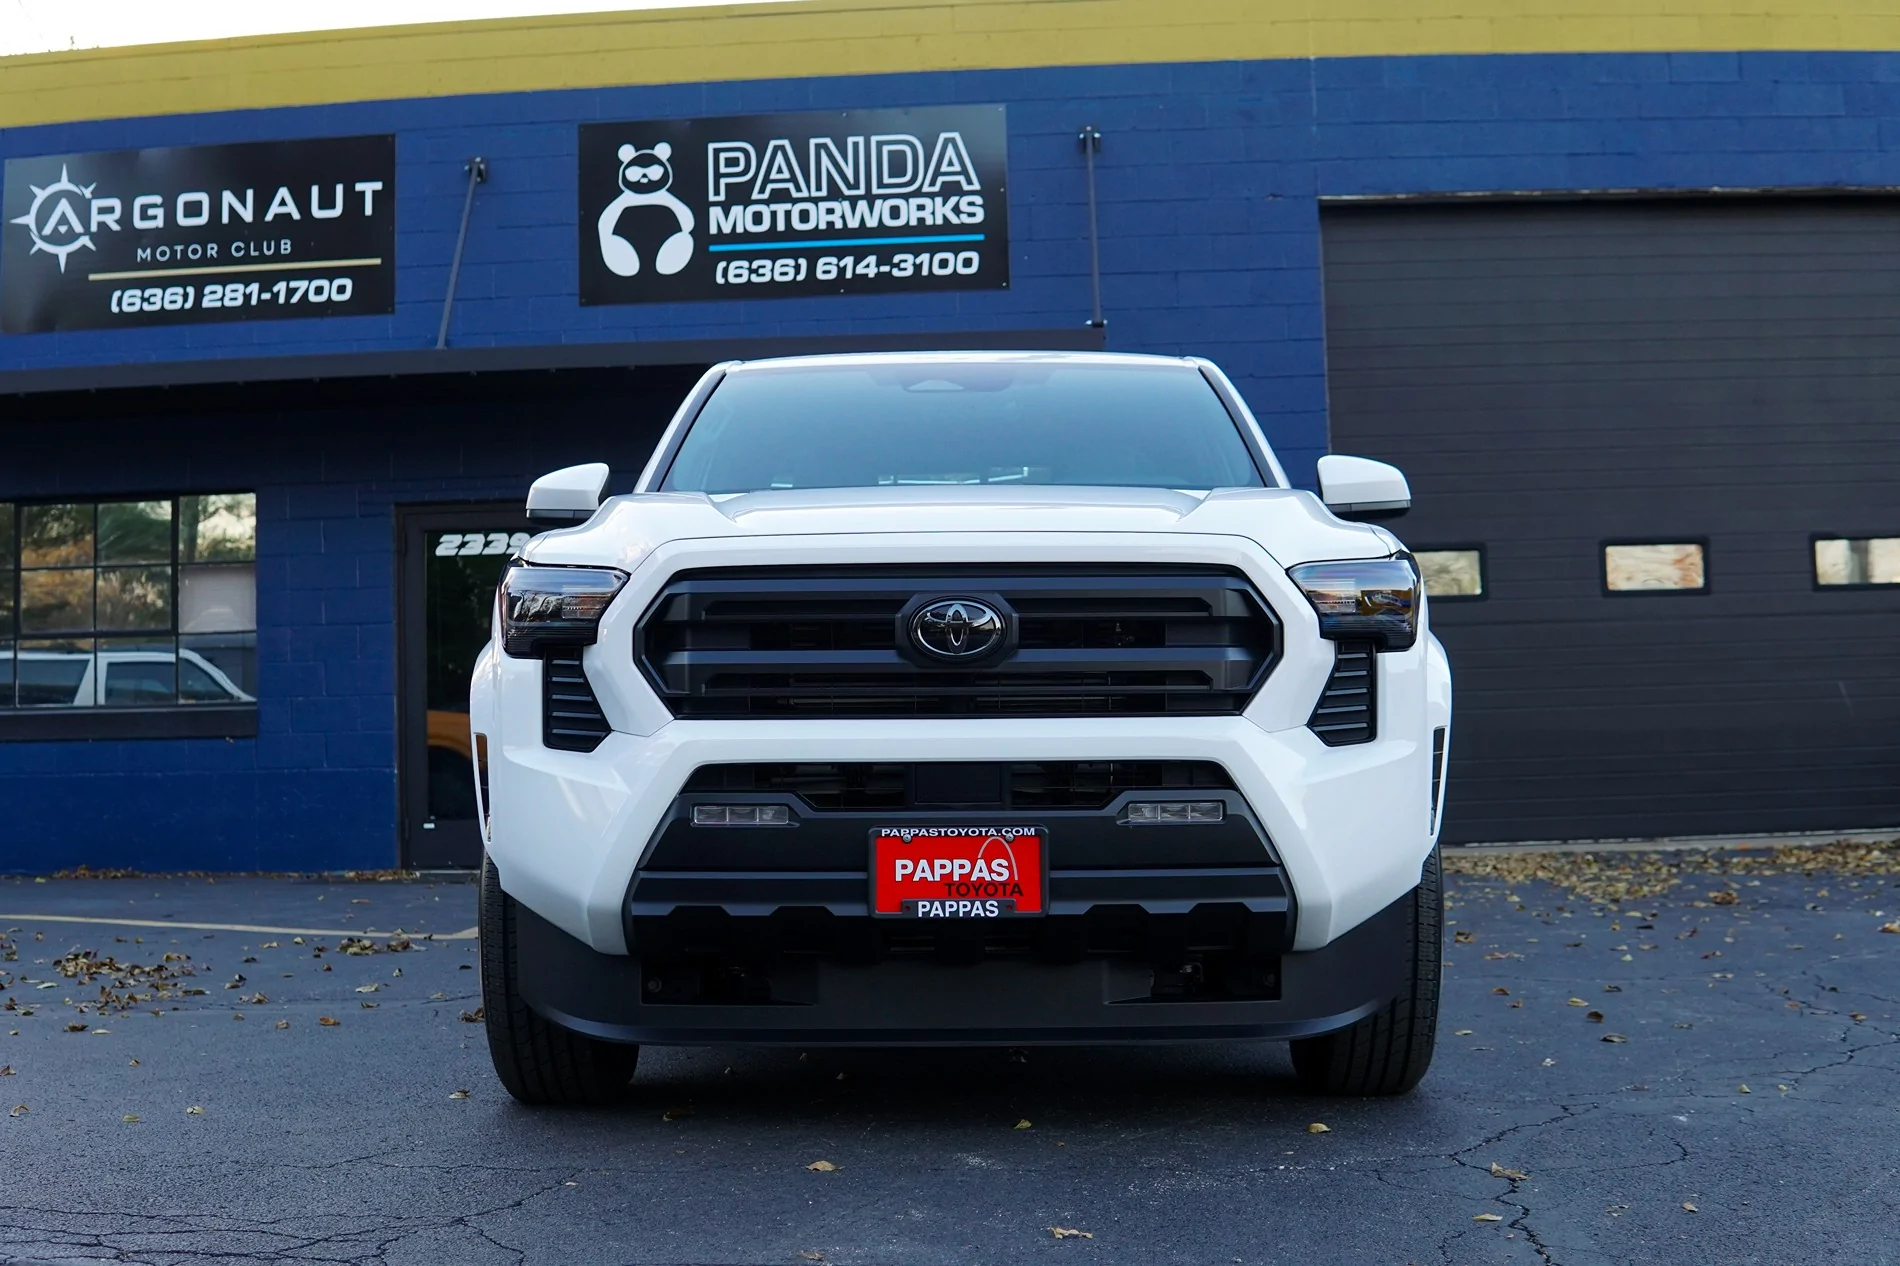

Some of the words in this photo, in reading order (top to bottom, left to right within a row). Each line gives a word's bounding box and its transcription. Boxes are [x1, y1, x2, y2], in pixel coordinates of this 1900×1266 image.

[708, 132, 981, 201] PANDA
[42, 181, 384, 236] ARGONAUT
[709, 195, 985, 234] MOTORWORKS
[137, 243, 218, 263] MOTOR
[231, 239, 292, 257] CLUB
[716, 257, 807, 284] (636)
[816, 251, 980, 281] 614-3100
[110, 286, 195, 314] (636)
[201, 277, 353, 309] 281-1700
[881, 827, 1036, 837] PAPPASTOYOTA.COM
[895, 859, 1010, 882] PAPPAS
[944, 882, 1024, 897] TOYOTA
[918, 900, 999, 918] PAPPAS
